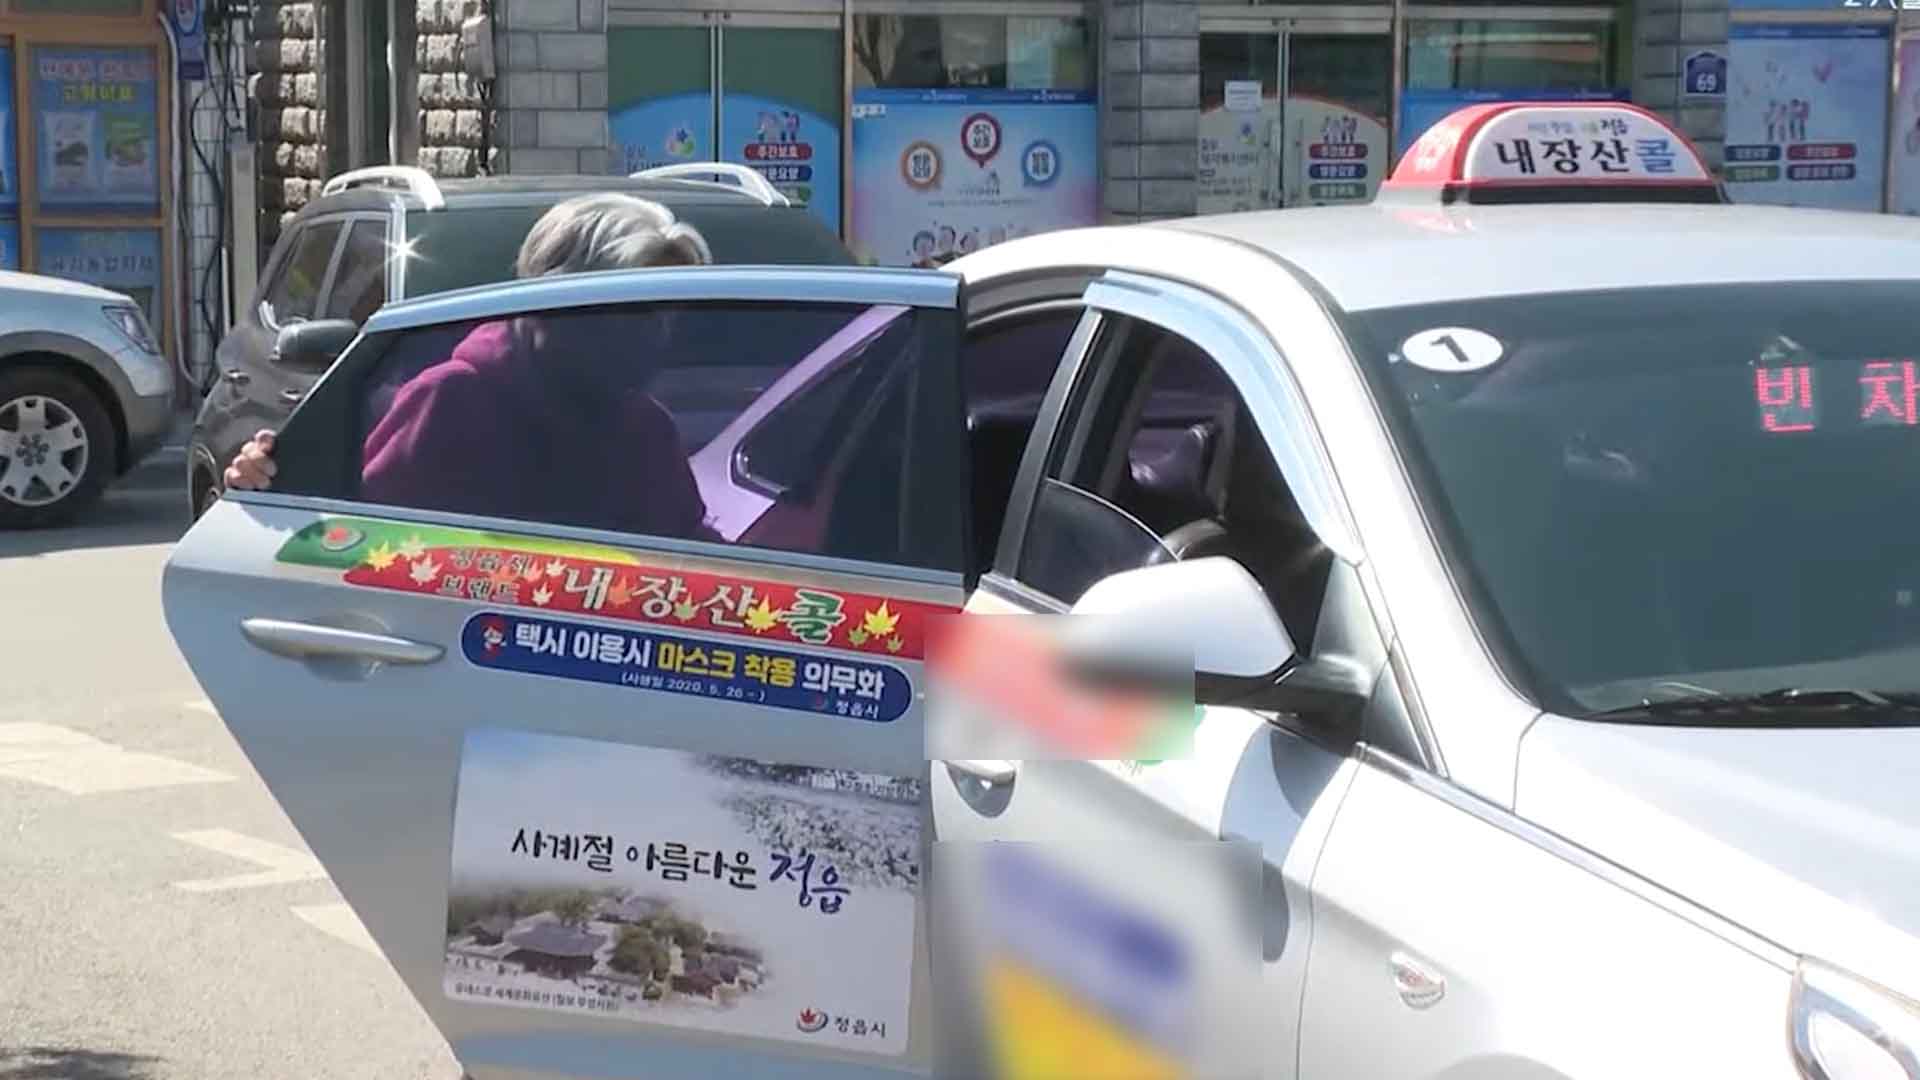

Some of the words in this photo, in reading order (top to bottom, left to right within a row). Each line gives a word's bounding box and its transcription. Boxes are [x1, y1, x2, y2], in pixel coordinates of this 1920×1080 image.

[1697, 72, 1716, 92] 69
[757, 145, 799, 159] 주간보호
[1496, 138, 1676, 175] 내장산콜
[1430, 335, 1470, 363] 1
[442, 575, 521, 604] 브랜드
[565, 565, 847, 645] 내장산콜
[515, 623, 566, 658] 택시
[573, 630, 651, 668] 이용시
[656, 642, 738, 679] 마스크
[743, 652, 797, 689] 착용
[801, 661, 885, 701] 의무화
[836, 700, 880, 719] 정읍시
[511, 826, 615, 873] 사계절
[625, 841, 757, 890] 아름다운
[768, 850, 851, 915] 정읍
[834, 1015, 887, 1039] 정읍시
